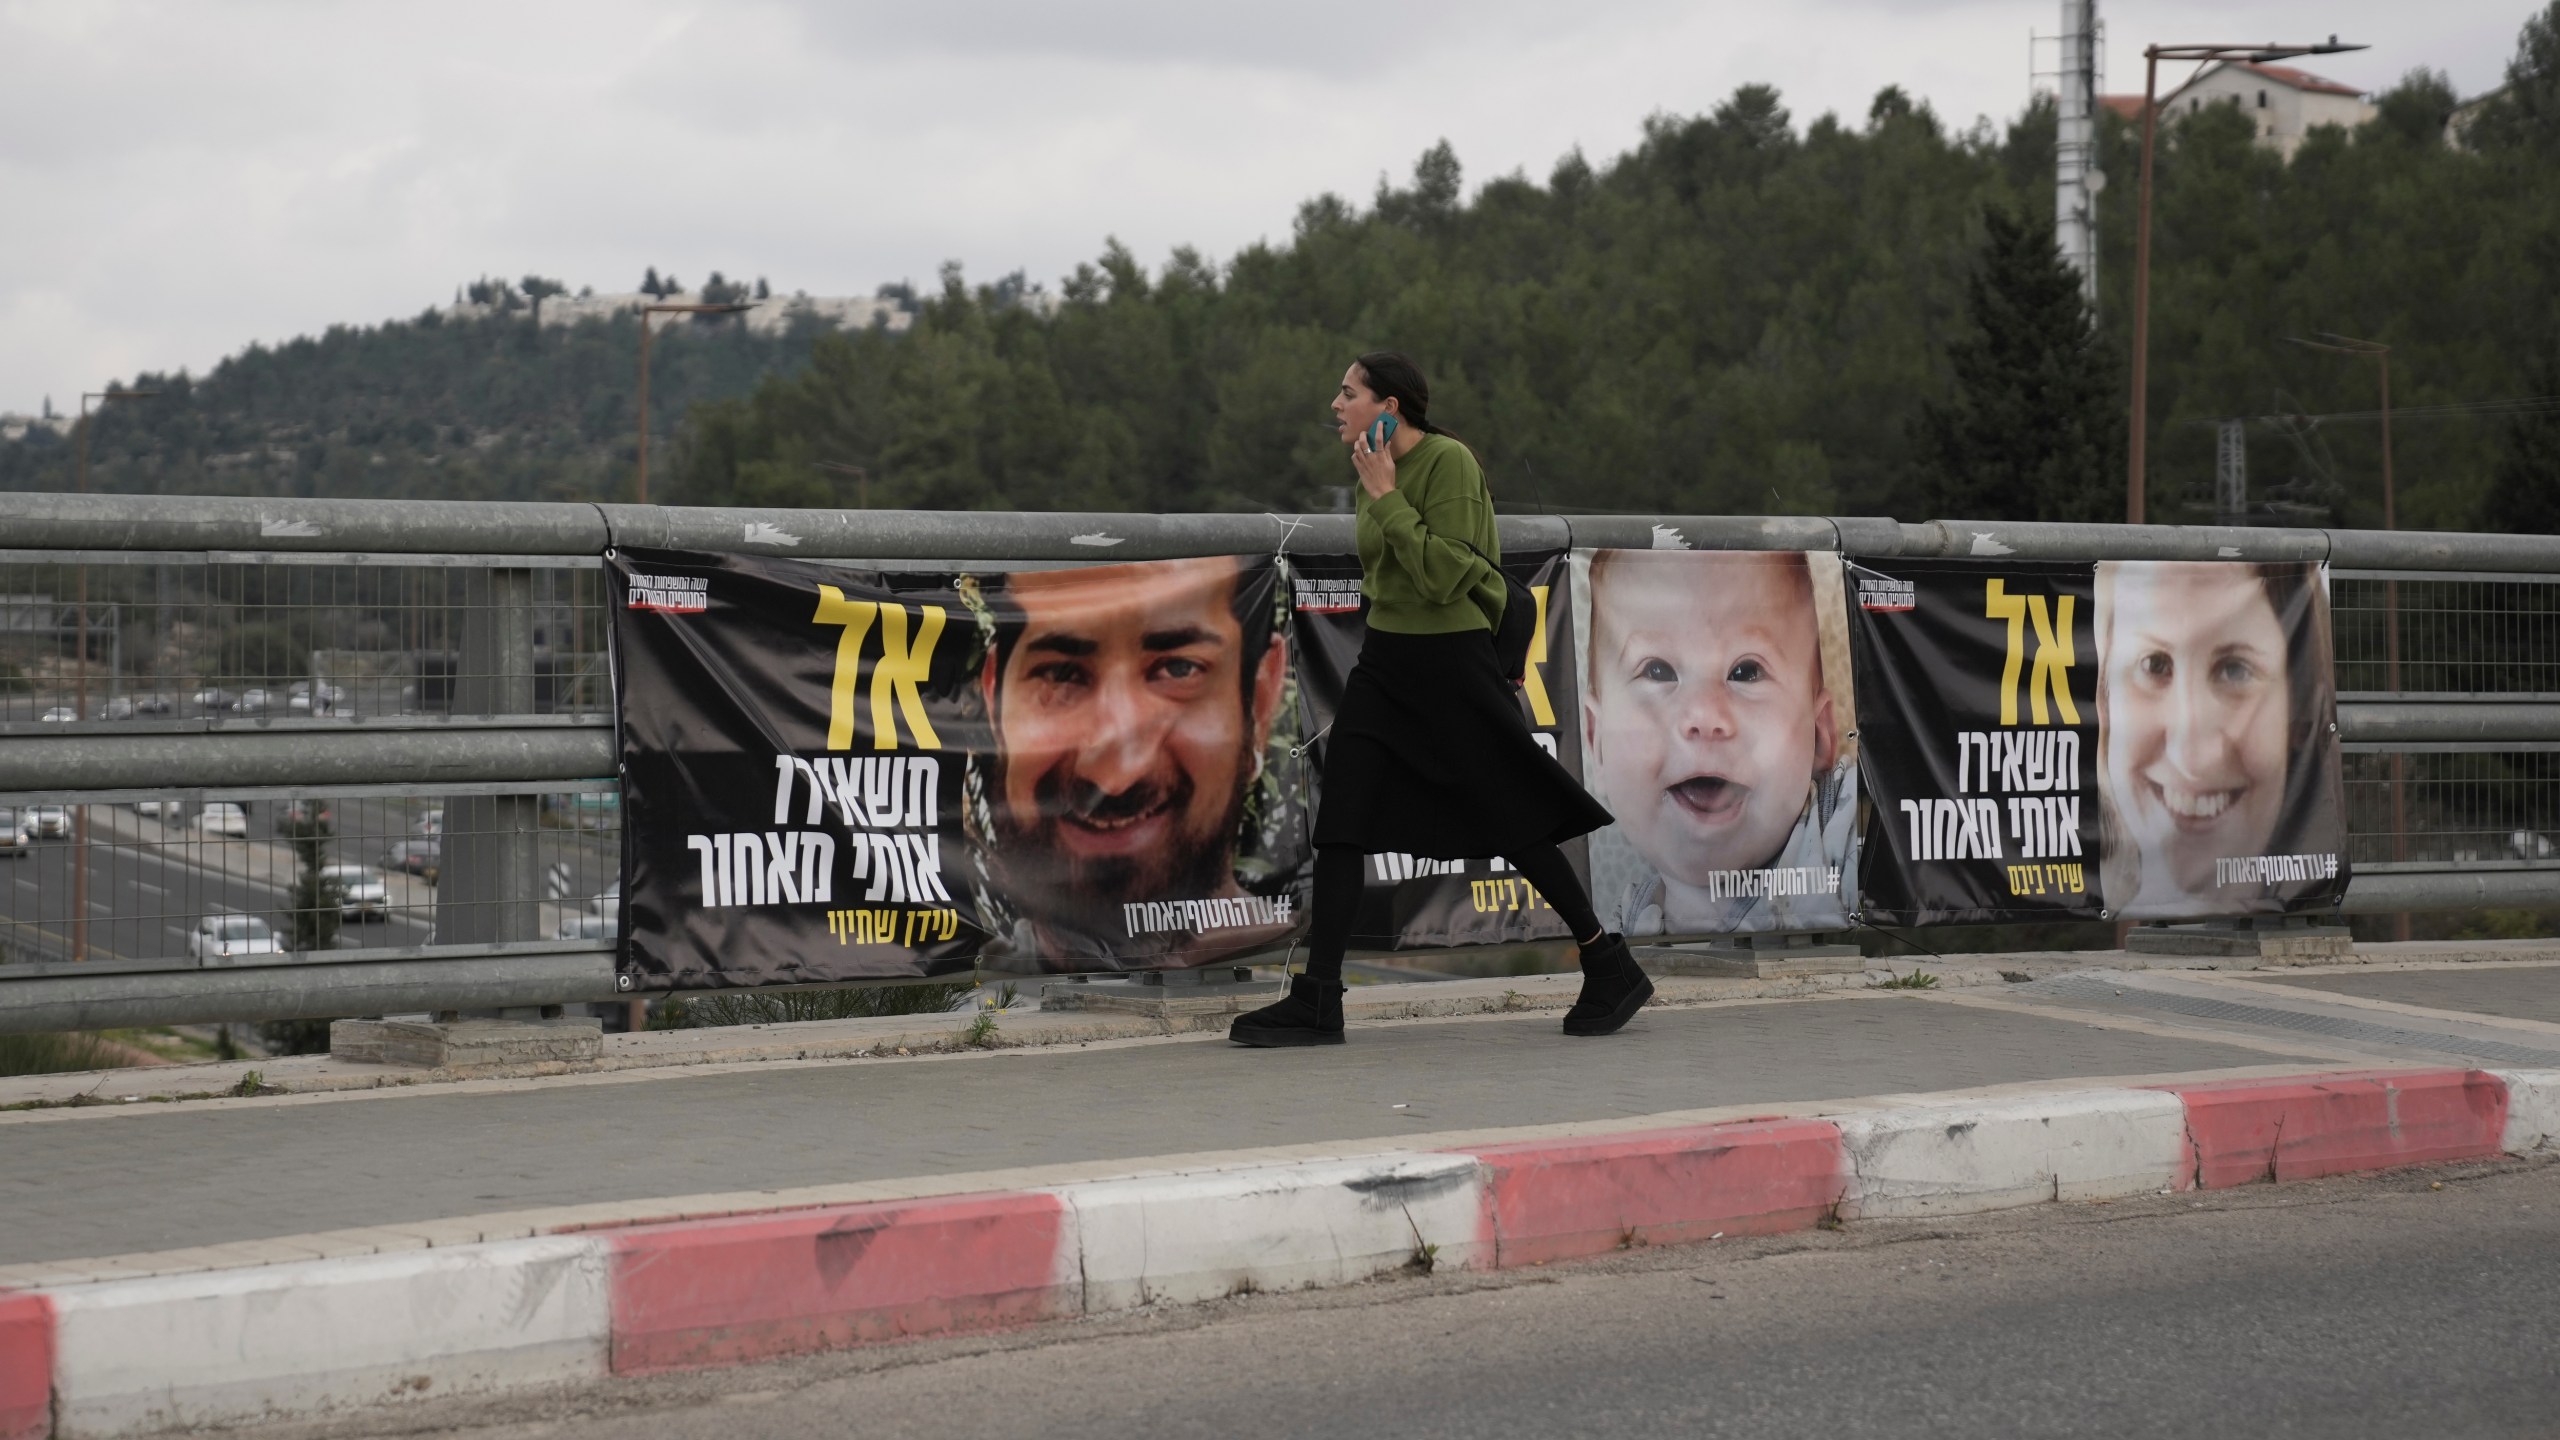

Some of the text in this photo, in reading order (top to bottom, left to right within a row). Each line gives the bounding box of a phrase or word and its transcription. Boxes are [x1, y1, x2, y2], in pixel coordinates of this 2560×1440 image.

[654, 575, 690, 590] המשפחות
[668, 591, 707, 609] החטופים
[690, 577, 708, 591] מטה
[1329, 592, 1361, 608] החטופים
[1887, 592, 1915, 608] החטופים
[812, 584, 947, 750] אל
[1986, 578, 2081, 725] אל
[1957, 730, 2081, 793] תשאירו
[774, 754, 940, 827] תשאירו
[1900, 796, 2083, 861] אותי מאחור
[687, 831, 952, 907] אותי מאחור
[2007, 863, 2085, 896] שירי ביבס
[1470, 878, 1519, 913] ביבס
[827, 908, 958, 948] עידן שתיוי
